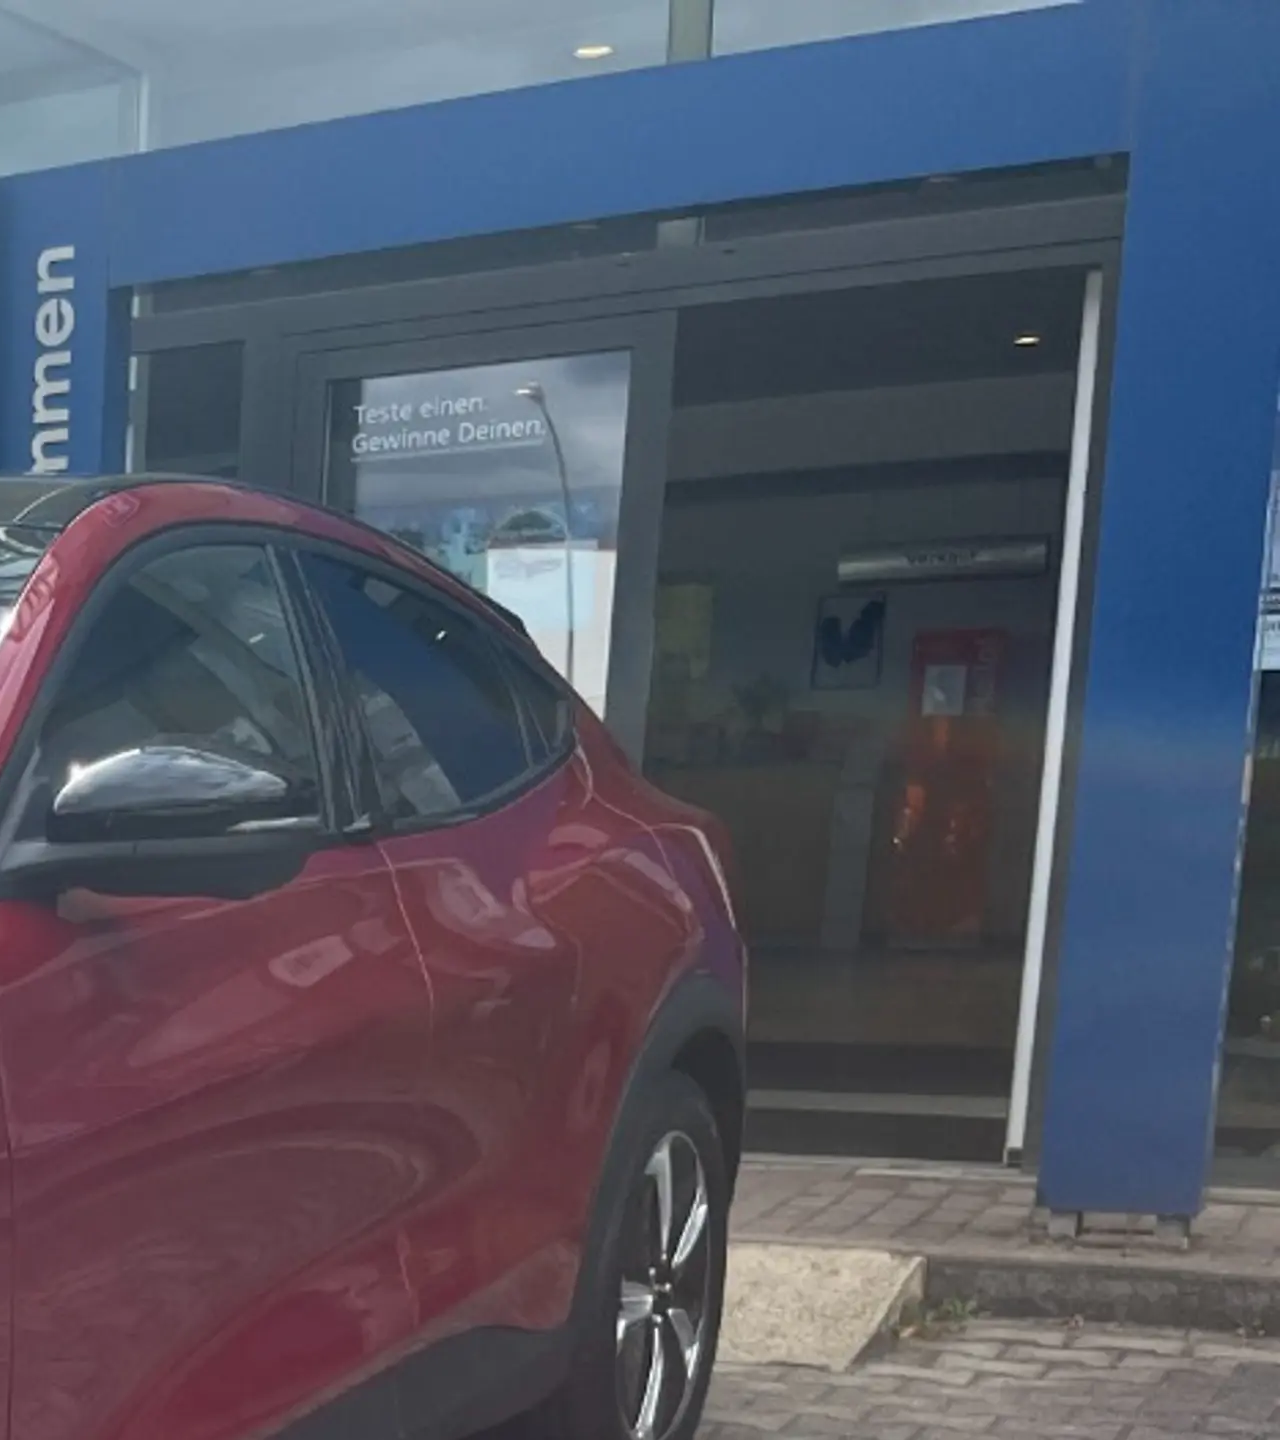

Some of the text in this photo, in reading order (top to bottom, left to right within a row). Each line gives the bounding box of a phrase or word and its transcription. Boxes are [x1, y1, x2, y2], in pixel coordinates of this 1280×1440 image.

[352, 402, 412, 426] Teste
[351, 417, 546, 454] Gewinne Deinen.
